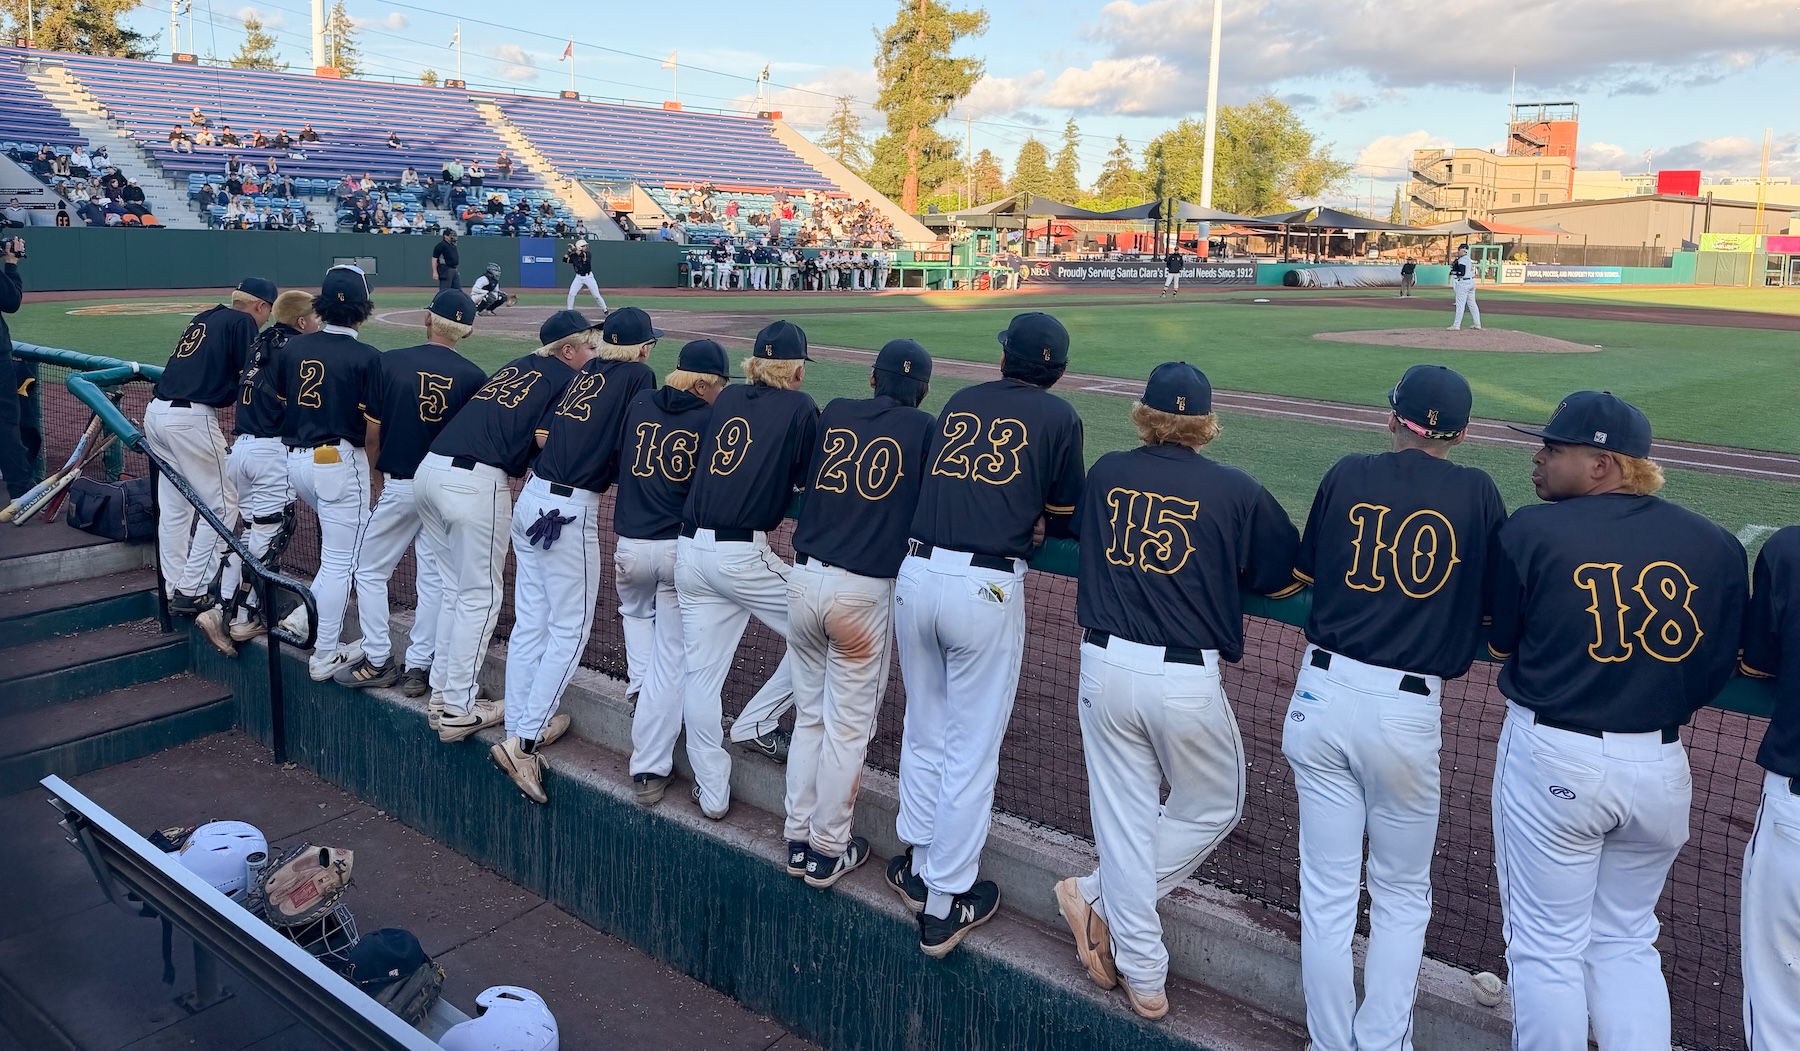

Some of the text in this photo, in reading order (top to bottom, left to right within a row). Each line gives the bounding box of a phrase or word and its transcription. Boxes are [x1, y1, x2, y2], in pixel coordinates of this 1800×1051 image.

[1030, 267, 1050, 277] NECA
[1058, 266, 1087, 280] Proudly
[1088, 266, 1116, 280] Serving
[1116, 267, 1138, 278] Santa
[1139, 267, 1163, 278] Clara's
[1196, 267, 1217, 278] Needs
[1218, 267, 1236, 278] Since
[1236, 267, 1254, 278] 1912
[297, 360, 325, 408] 2
[416, 371, 454, 422] 5
[471, 366, 542, 409] 24
[555, 370, 606, 422] 12
[632, 422, 699, 482] 16
[710, 416, 753, 476] 9
[815, 426, 904, 500] 20
[932, 412, 1029, 485] 23
[1106, 486, 1200, 575] 15
[1345, 502, 1462, 599] 10
[1573, 560, 1704, 663] 18
[960, 904, 975, 923] N
